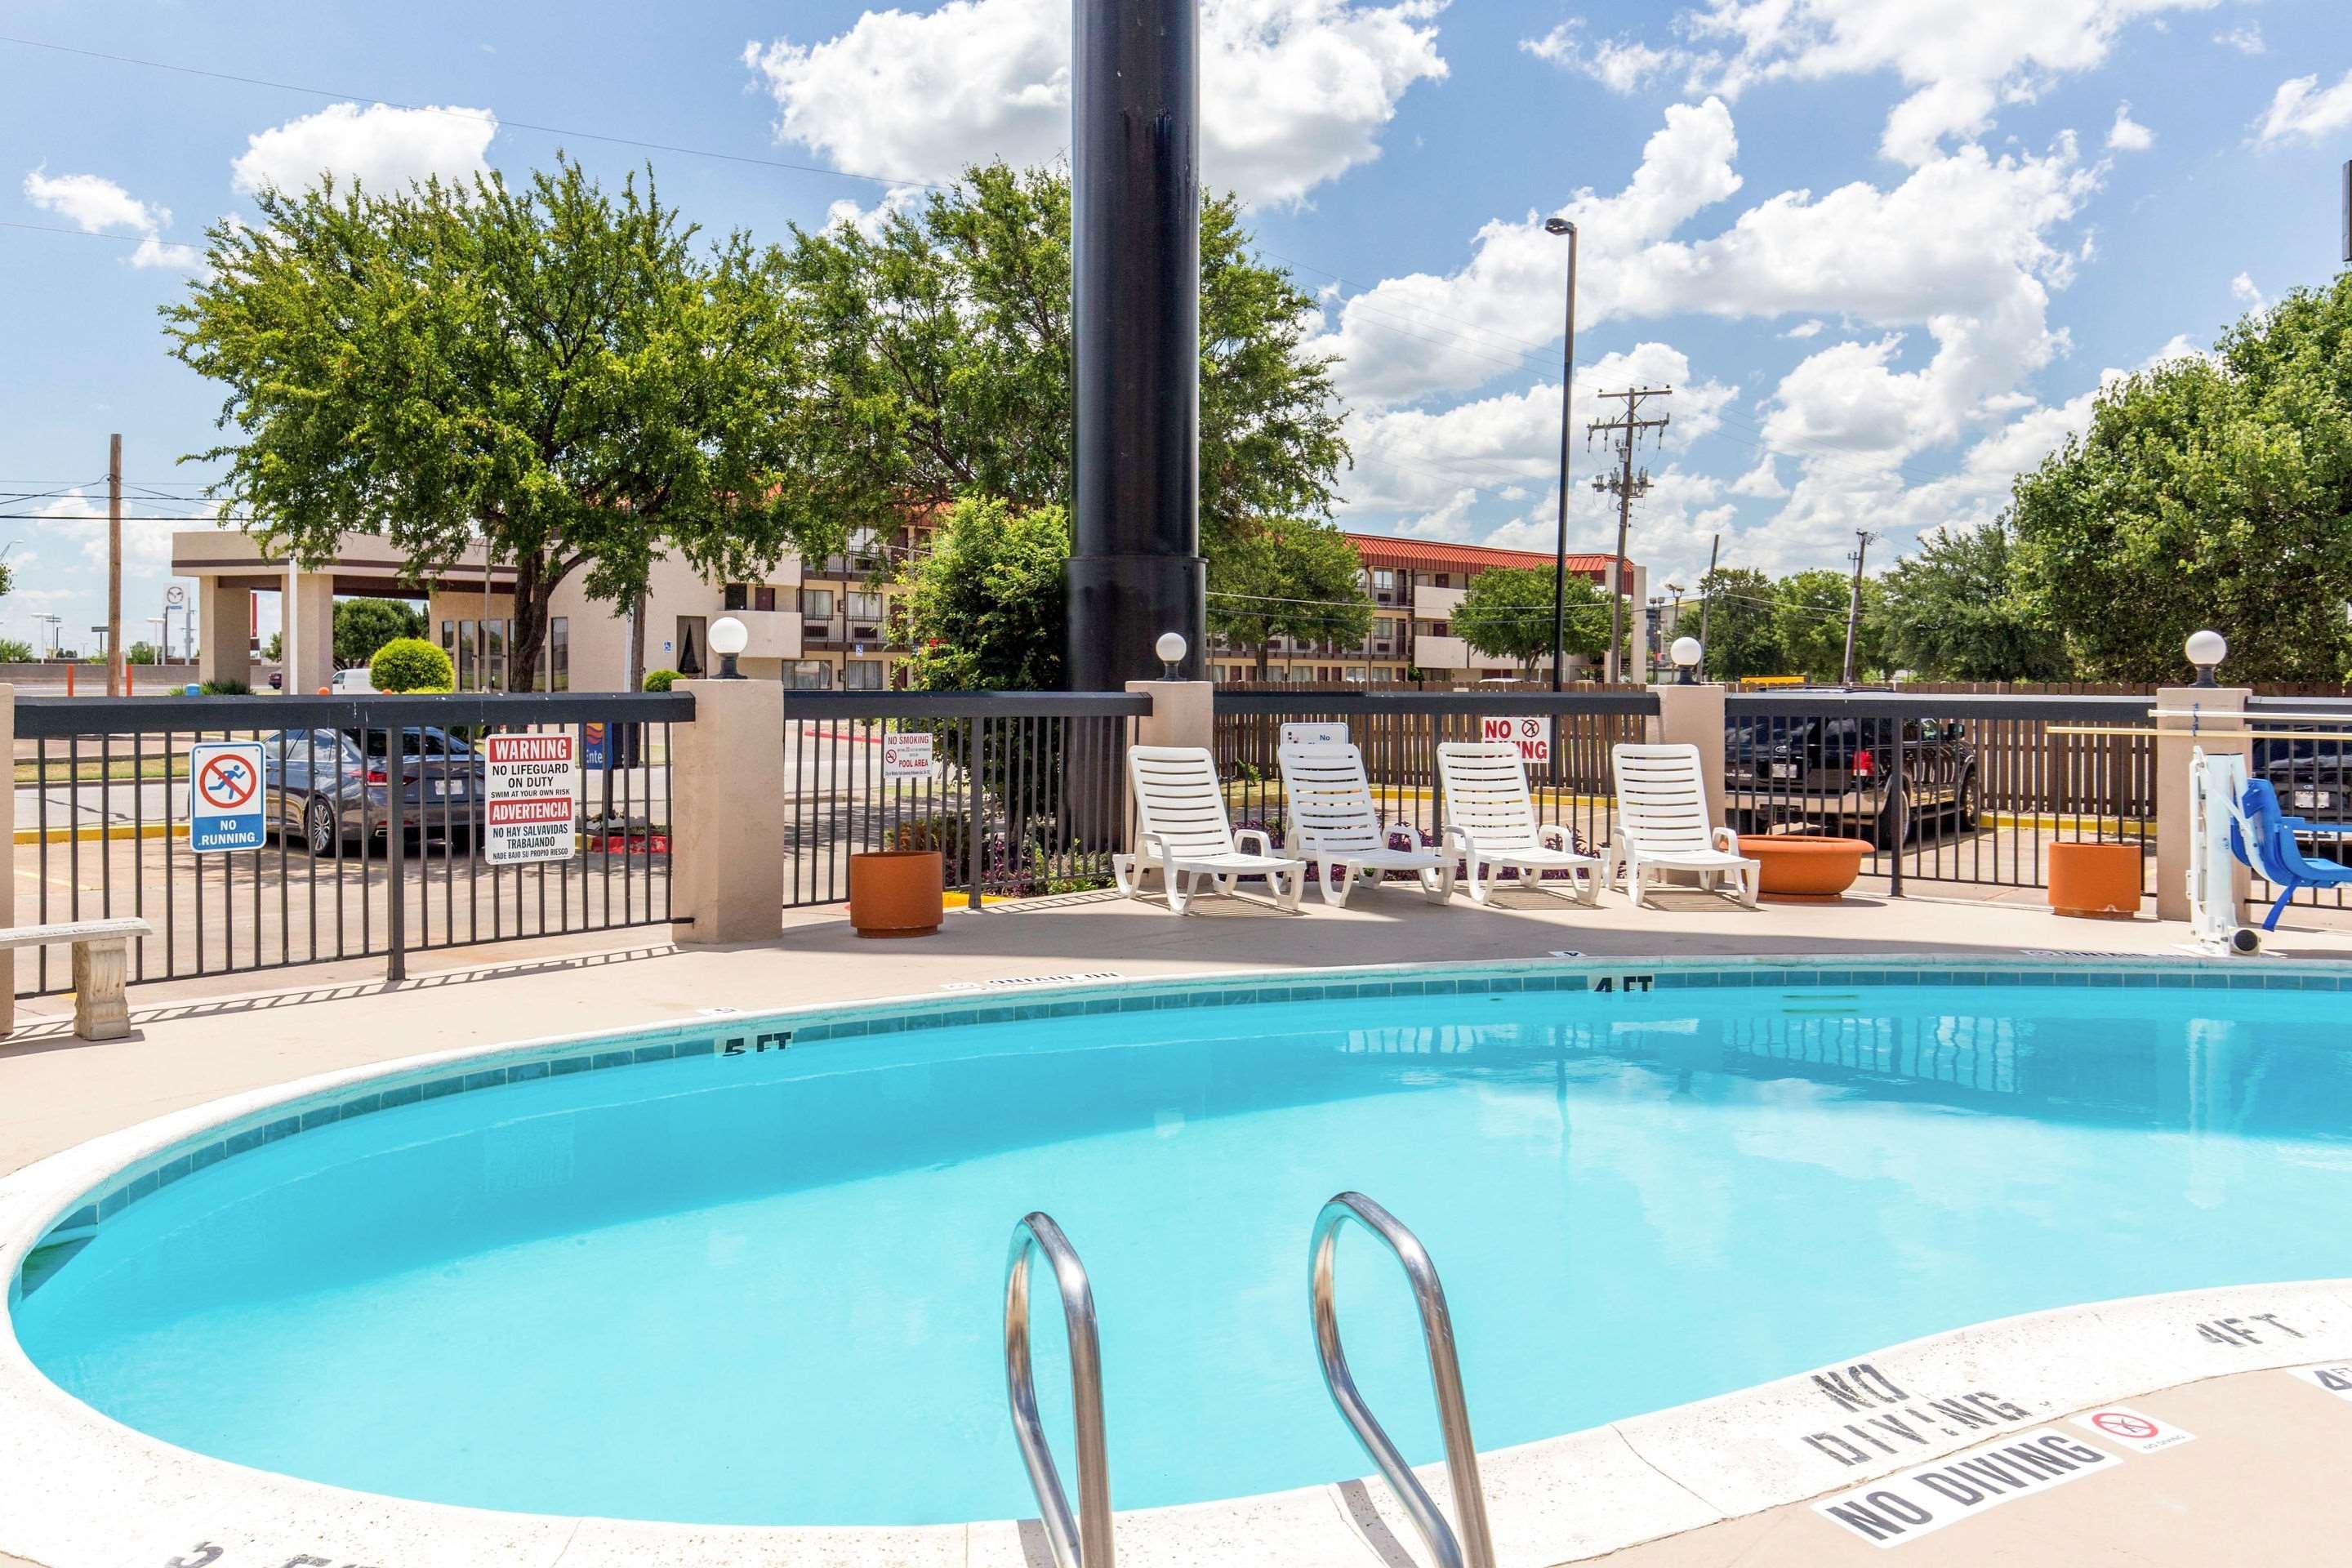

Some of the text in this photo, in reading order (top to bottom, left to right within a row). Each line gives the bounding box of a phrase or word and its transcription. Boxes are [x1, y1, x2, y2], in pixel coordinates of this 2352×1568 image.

[1485, 719, 1512, 739] NO
[888, 735, 929, 745] NO SMOKING
[495, 738, 568, 760] WARNING
[492, 763, 568, 776] NO LIFEGUARD
[898, 759, 929, 768] POOL AREA
[508, 776, 554, 788] ON DUTY
[491, 791, 510, 799] SWIM
[492, 801, 569, 821] ADVERTENCIA
[220, 820, 237, 831] NO
[492, 823, 568, 838] NO HAY SALVAVIDAS
[201, 832, 256, 845] RUNNING
[506, 836, 555, 849] TRABAJANDO
[492, 848, 568, 860] NADE BAJO SU PROPIO RIESGO
[1594, 975, 1653, 993] 4 FT
[722, 1031, 792, 1057] 5 FT
[1809, 1363, 1911, 1413] NO
[1801, 1391, 2032, 1467] DIVING
[1824, 1435, 2105, 1541] NO DIVING
